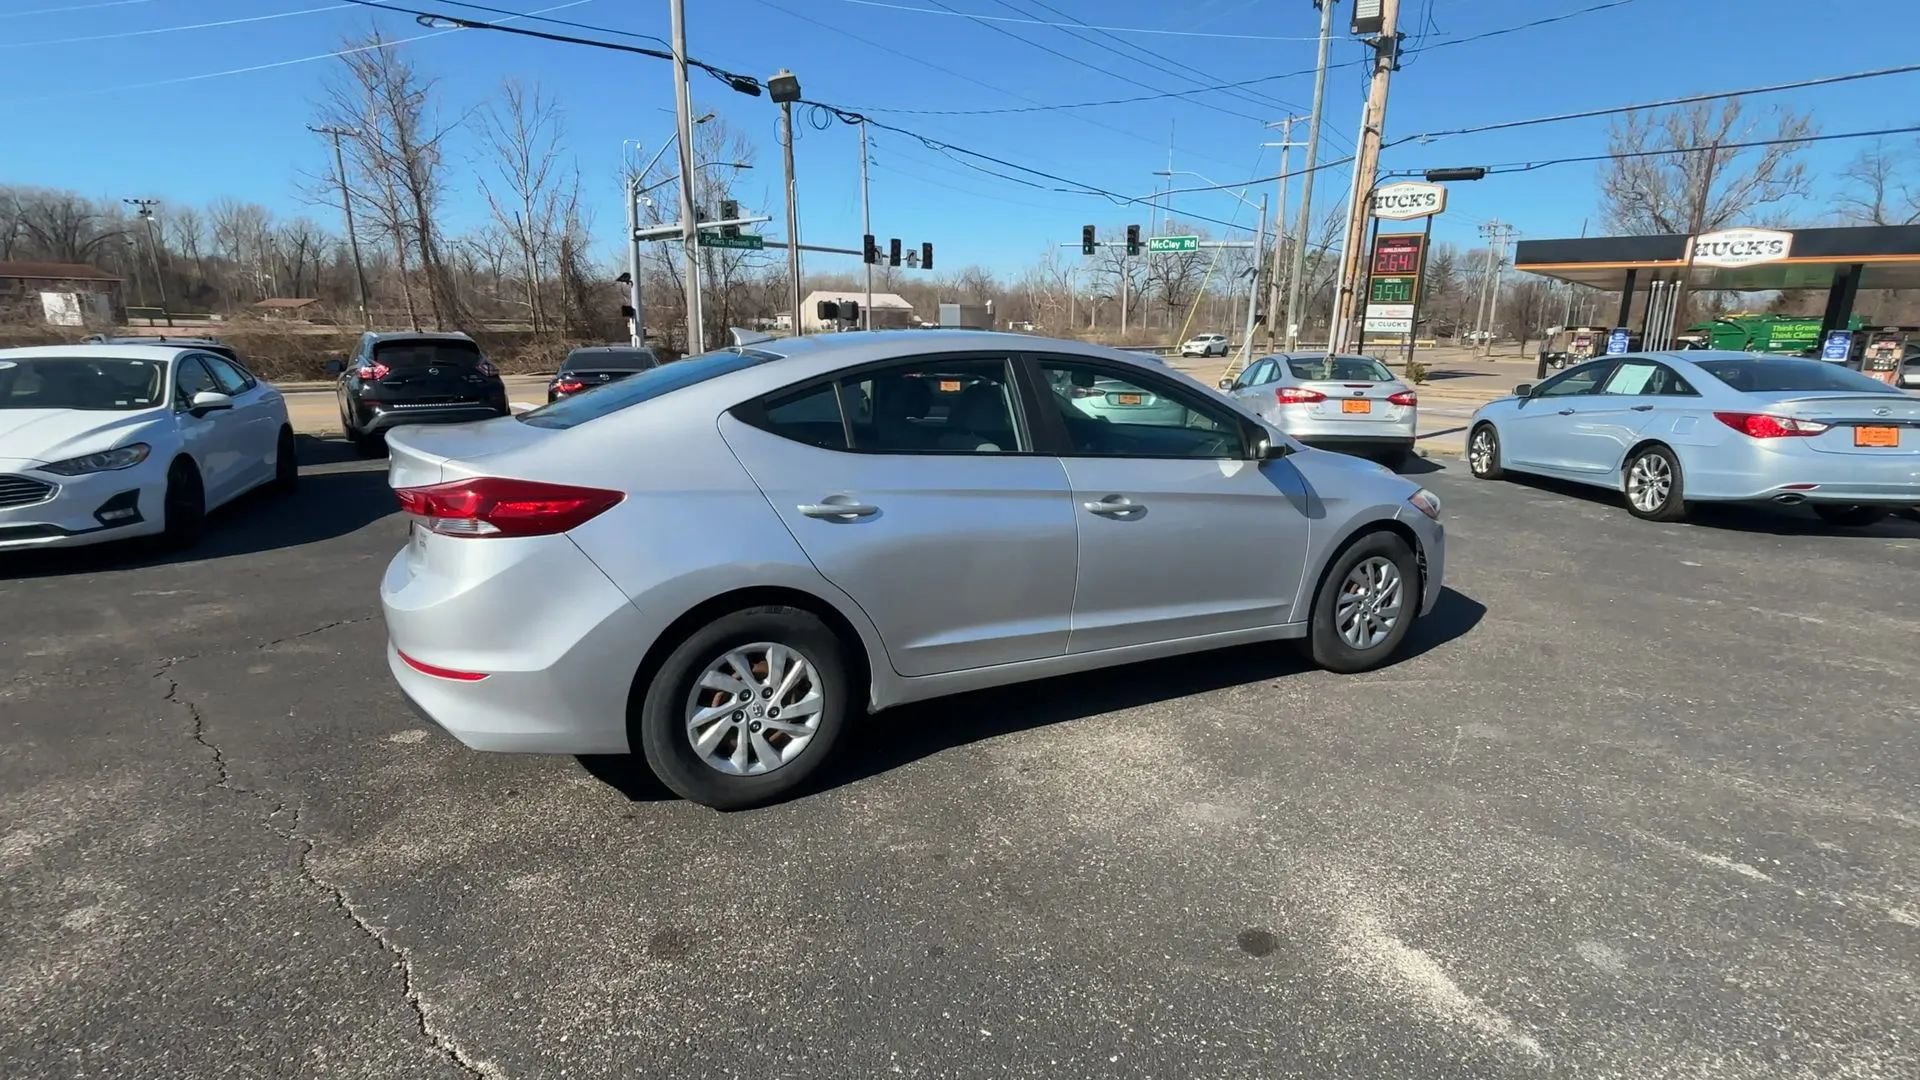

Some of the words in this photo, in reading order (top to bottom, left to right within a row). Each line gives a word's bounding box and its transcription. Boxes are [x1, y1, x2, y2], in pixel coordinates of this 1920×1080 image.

[1372, 193, 1436, 209] HUCK'S
[1151, 239, 1180, 249] McClay
[1184, 239, 1195, 248] Rd
[1695, 239, 1784, 256] HUCK'S
